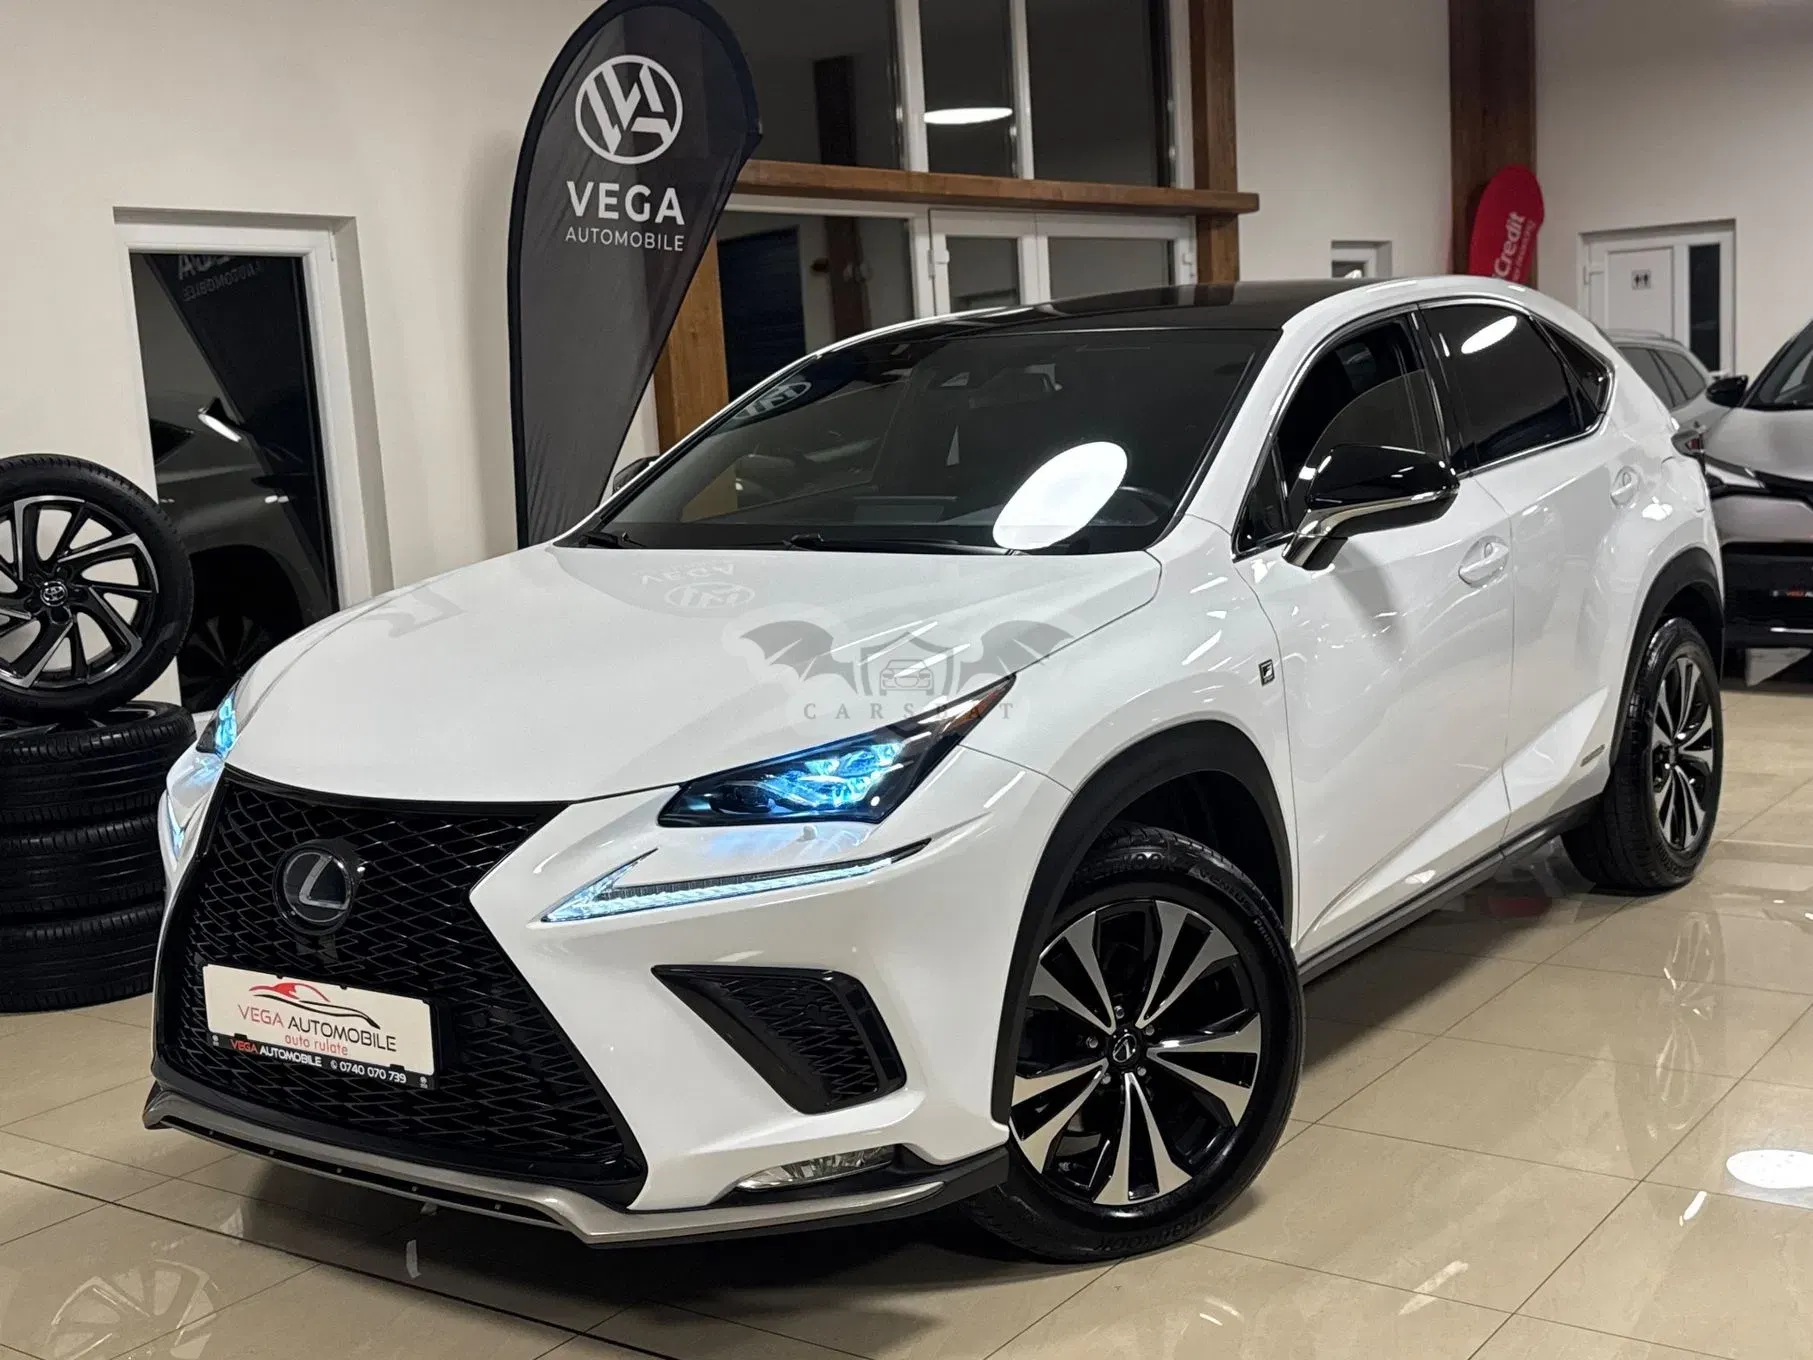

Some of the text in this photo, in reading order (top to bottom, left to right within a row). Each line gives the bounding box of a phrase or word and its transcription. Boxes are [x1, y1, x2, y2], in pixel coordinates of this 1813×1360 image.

[566, 180, 685, 225] VEGA
[565, 226, 685, 252] AUTOMOBILE
[237, 1004, 397, 1052] VEGA AUTOMOBILE
[284, 1034, 349, 1056] auto rulate
[230, 1039, 407, 1084] VEGA AUTOMOBILE 0740 070 739
